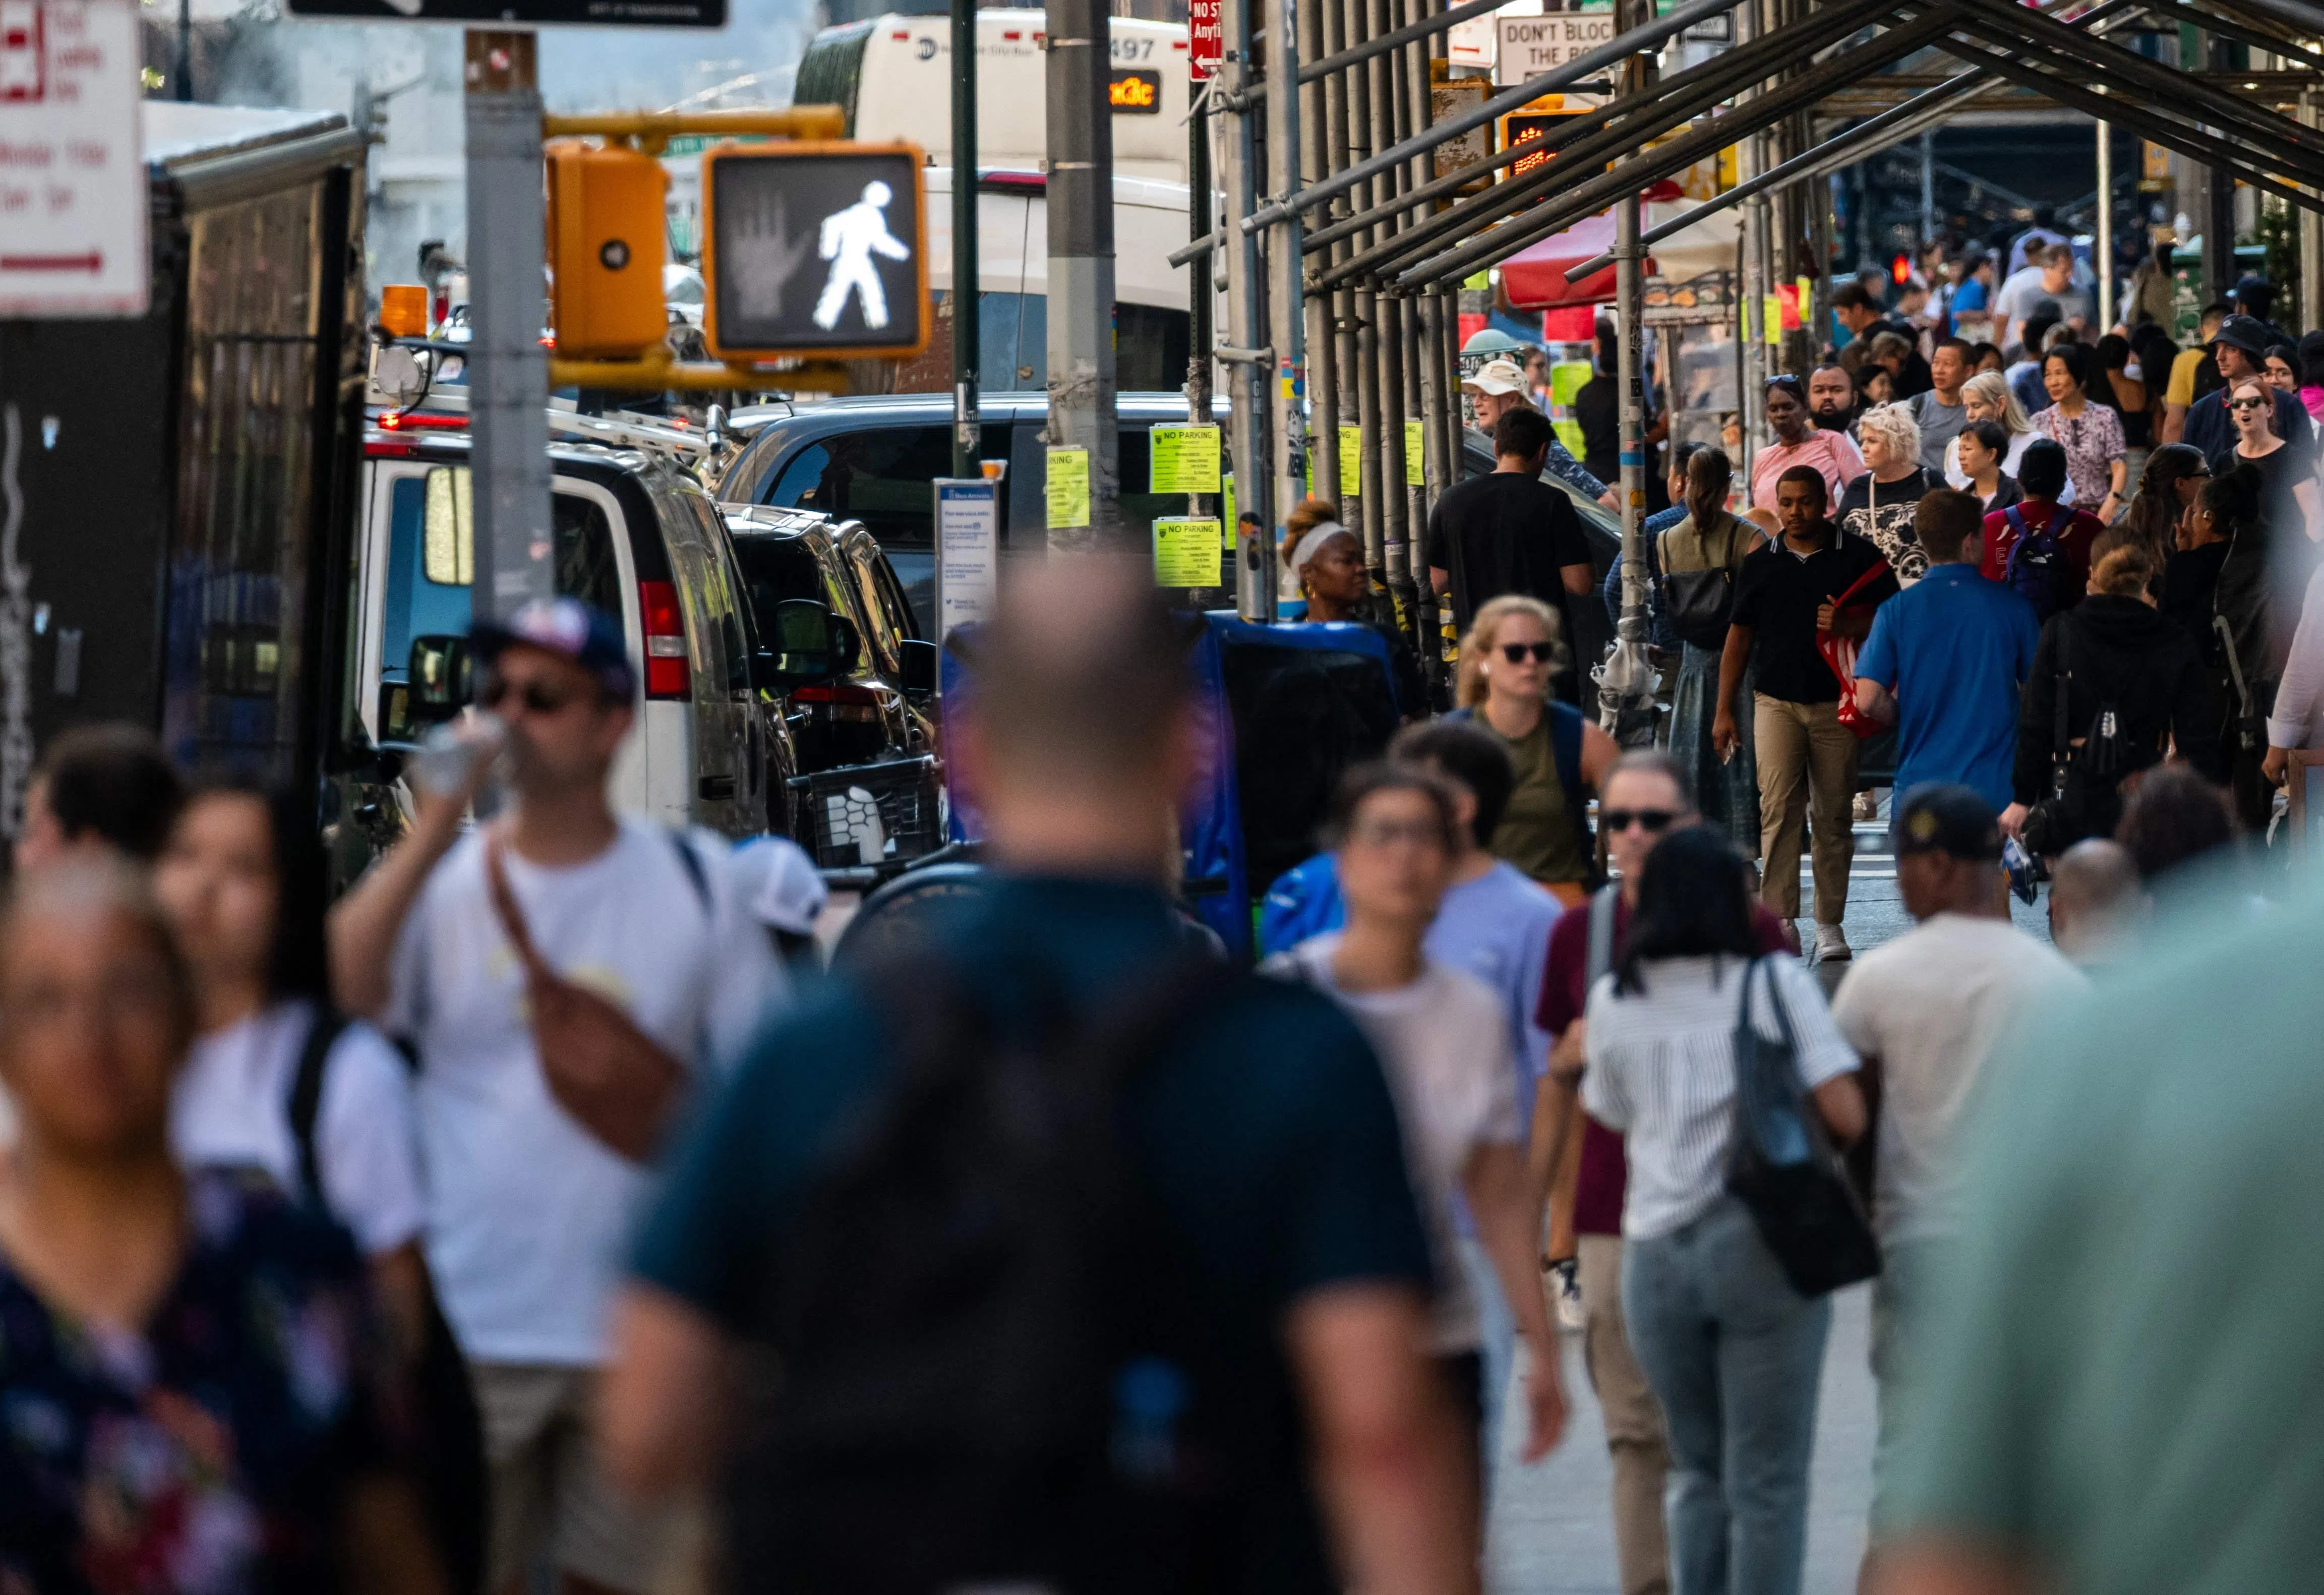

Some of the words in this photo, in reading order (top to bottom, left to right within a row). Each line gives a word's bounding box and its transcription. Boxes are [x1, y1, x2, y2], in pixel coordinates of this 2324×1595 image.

[1194, 2, 1208, 18] NO
[1195, 22, 1221, 41] Anyti
[1507, 23, 1558, 42] DON'T
[1529, 47, 1561, 65] THE
